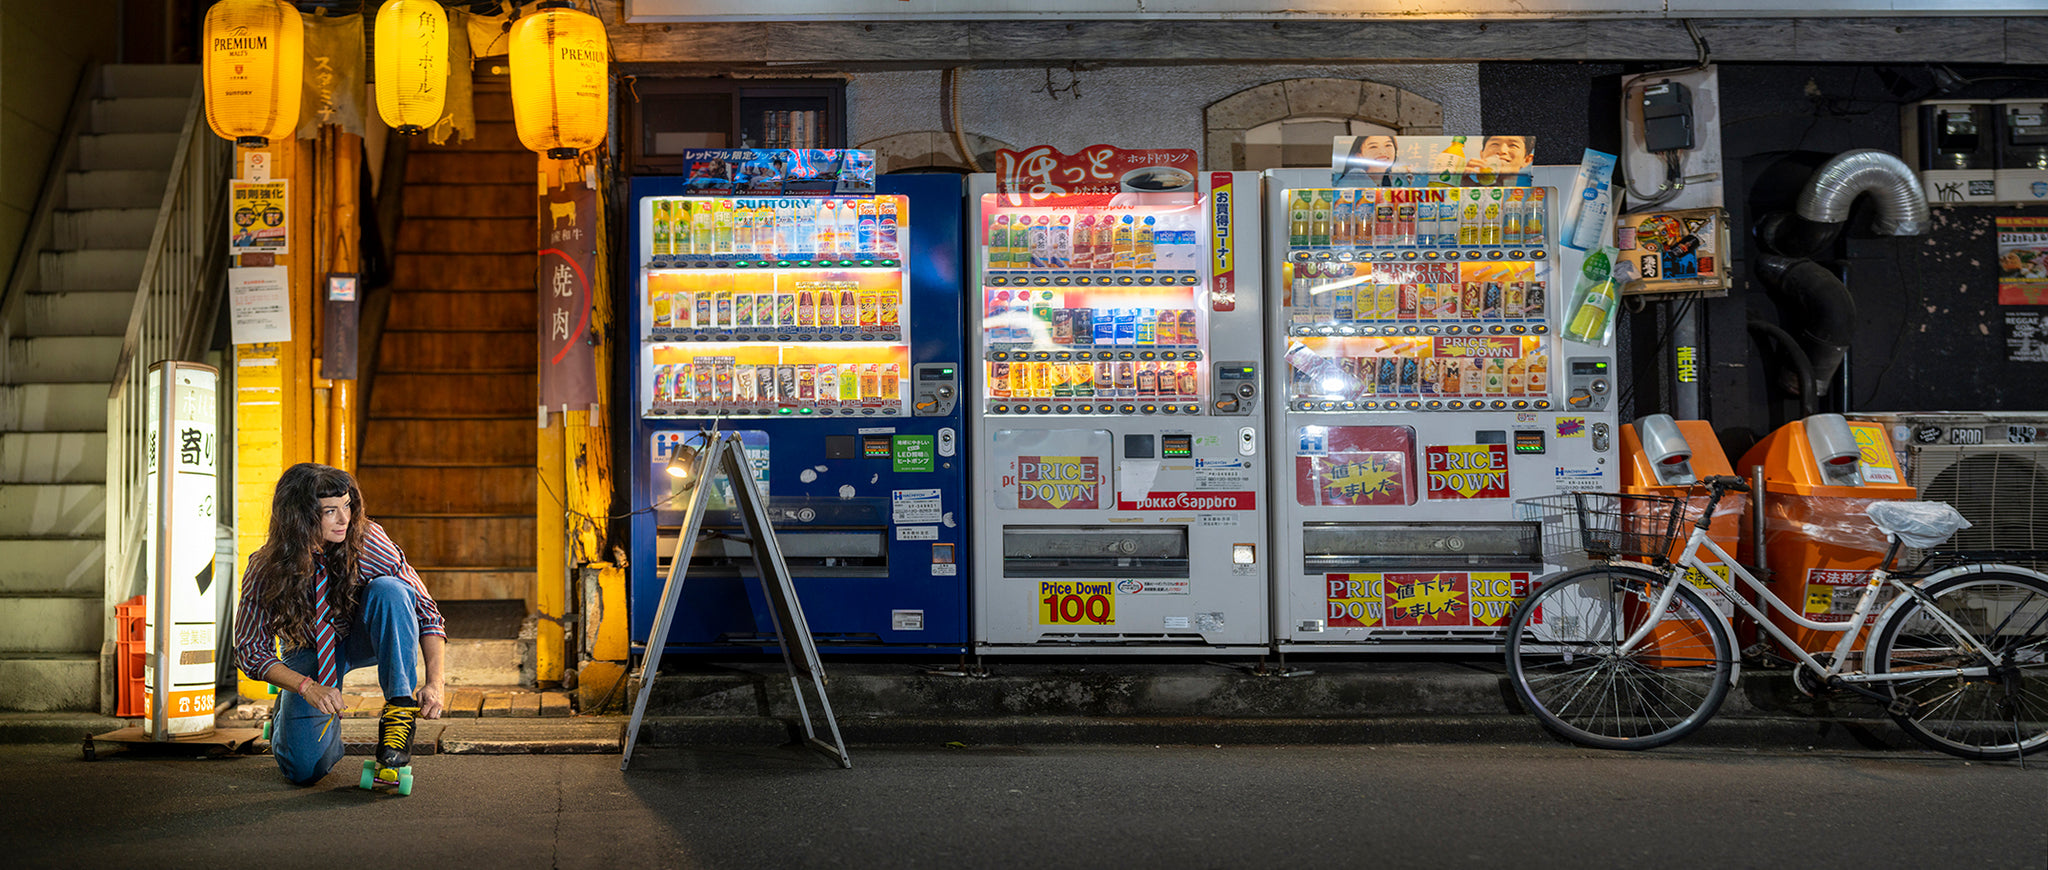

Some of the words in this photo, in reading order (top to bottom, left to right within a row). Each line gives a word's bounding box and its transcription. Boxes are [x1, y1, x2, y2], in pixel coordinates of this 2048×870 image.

[214, 36, 267, 51] PREMIUM
[417, 11, 436, 95] 角ハイボール
[313, 56, 334, 120] スタミナ
[1127, 152, 1190, 165] ホットドリンク
[1003, 148, 1115, 206] ほっと
[1073, 185, 1118, 196] あたたまる
[1391, 189, 1444, 203] KIRIN
[736, 199, 811, 209] SUNTORY
[1216, 192, 1230, 268] お買得コーナー
[552, 264, 573, 341] 焼肉
[1442, 337, 1488, 347] PRICE
[1465, 347, 1513, 357] DOWN
[1952, 429, 1981, 444] CROD
[181, 427, 215, 467] 寄り
[1331, 457, 1390, 480] 値下げ
[1428, 451, 1506, 471] PRICE
[1020, 462, 1096, 481] PRICE
[1328, 479, 1396, 500] しました
[1428, 472, 1506, 492] DOWN
[1020, 483, 1096, 501] DOWN
[1136, 495, 1177, 510] pokka
[1041, 582, 1071, 595] Price
[1076, 582, 1112, 595] Down!
[1329, 580, 1382, 598] PRIC
[1395, 576, 1457, 600] 値下げ
[1471, 579, 1527, 597] RICE
[1329, 601, 1382, 620] DOW
[1393, 598, 1462, 621] しました
[1472, 600, 1524, 619] OWN
